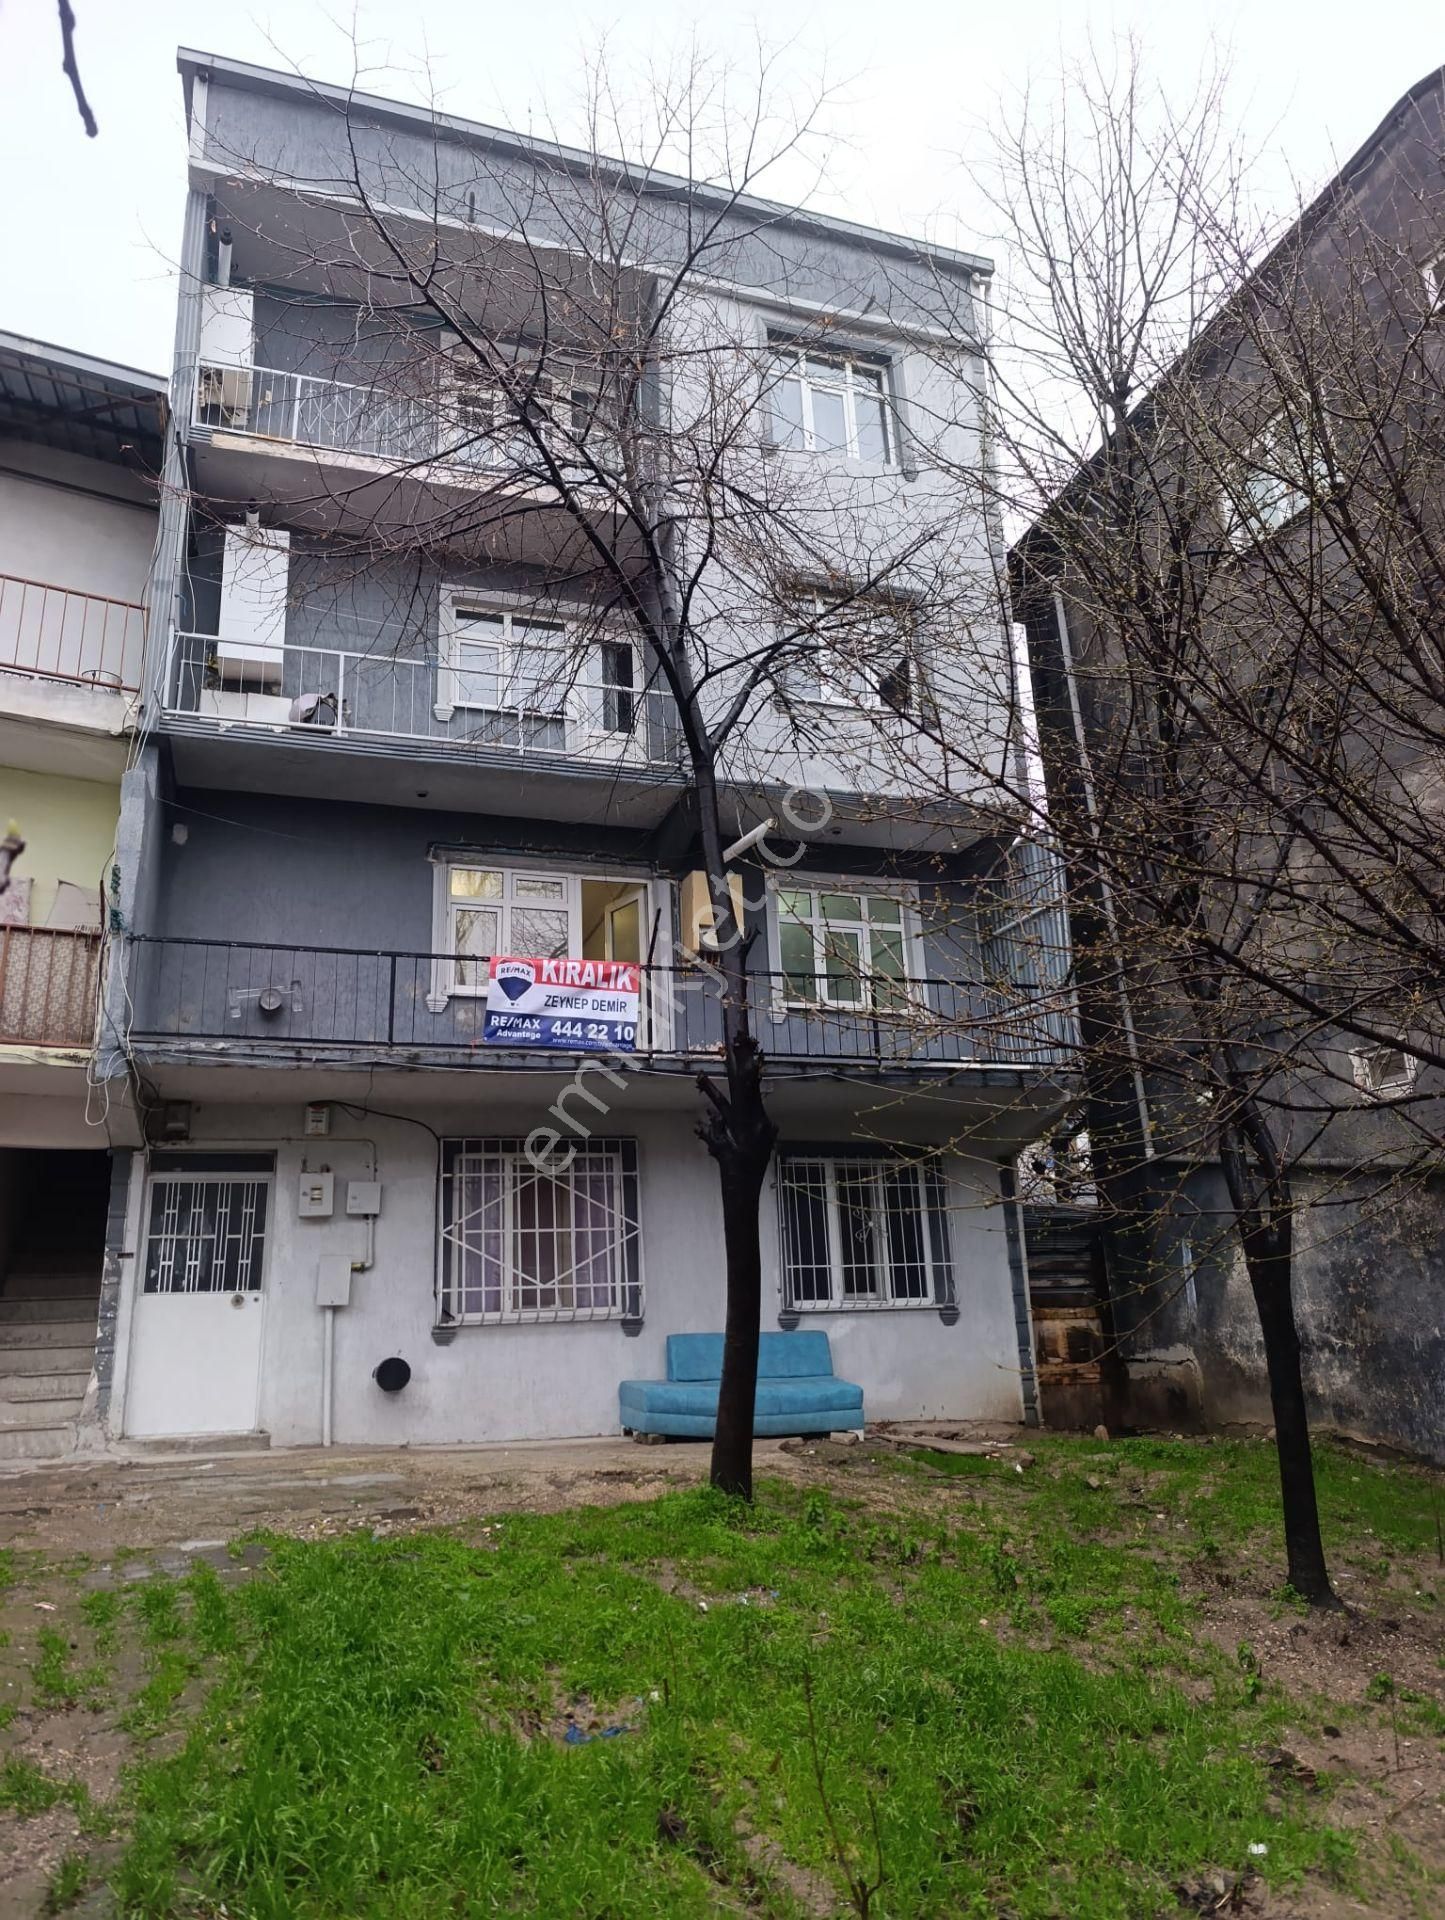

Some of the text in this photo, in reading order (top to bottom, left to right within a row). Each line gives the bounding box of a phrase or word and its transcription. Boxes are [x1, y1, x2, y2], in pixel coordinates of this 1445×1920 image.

[500, 966, 531, 976] RE/MAX
[544, 994, 627, 1013] ZEYNEP DEMİR
[490, 1015, 541, 1030] RE/MAX
[496, 1029, 541, 1040] Advantage
[550, 1020, 634, 1041] 444 22 10
